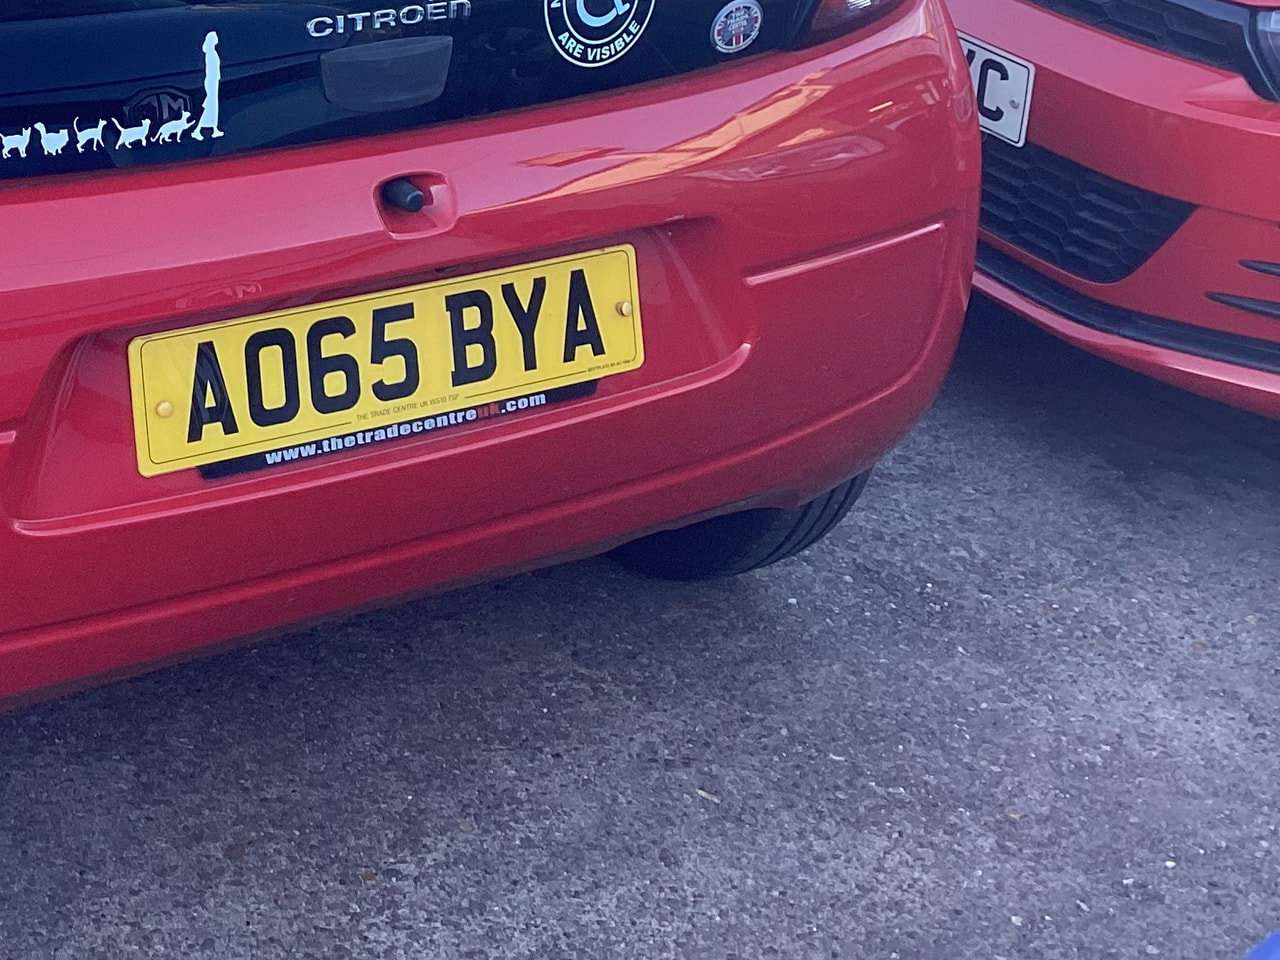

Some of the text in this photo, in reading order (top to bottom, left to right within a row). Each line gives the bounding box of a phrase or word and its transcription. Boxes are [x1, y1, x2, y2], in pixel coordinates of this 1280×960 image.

[558, 20, 640, 61] ARE VISIBLE
[966, 48, 1009, 122] C
[187, 268, 606, 444] AO65 BYA
